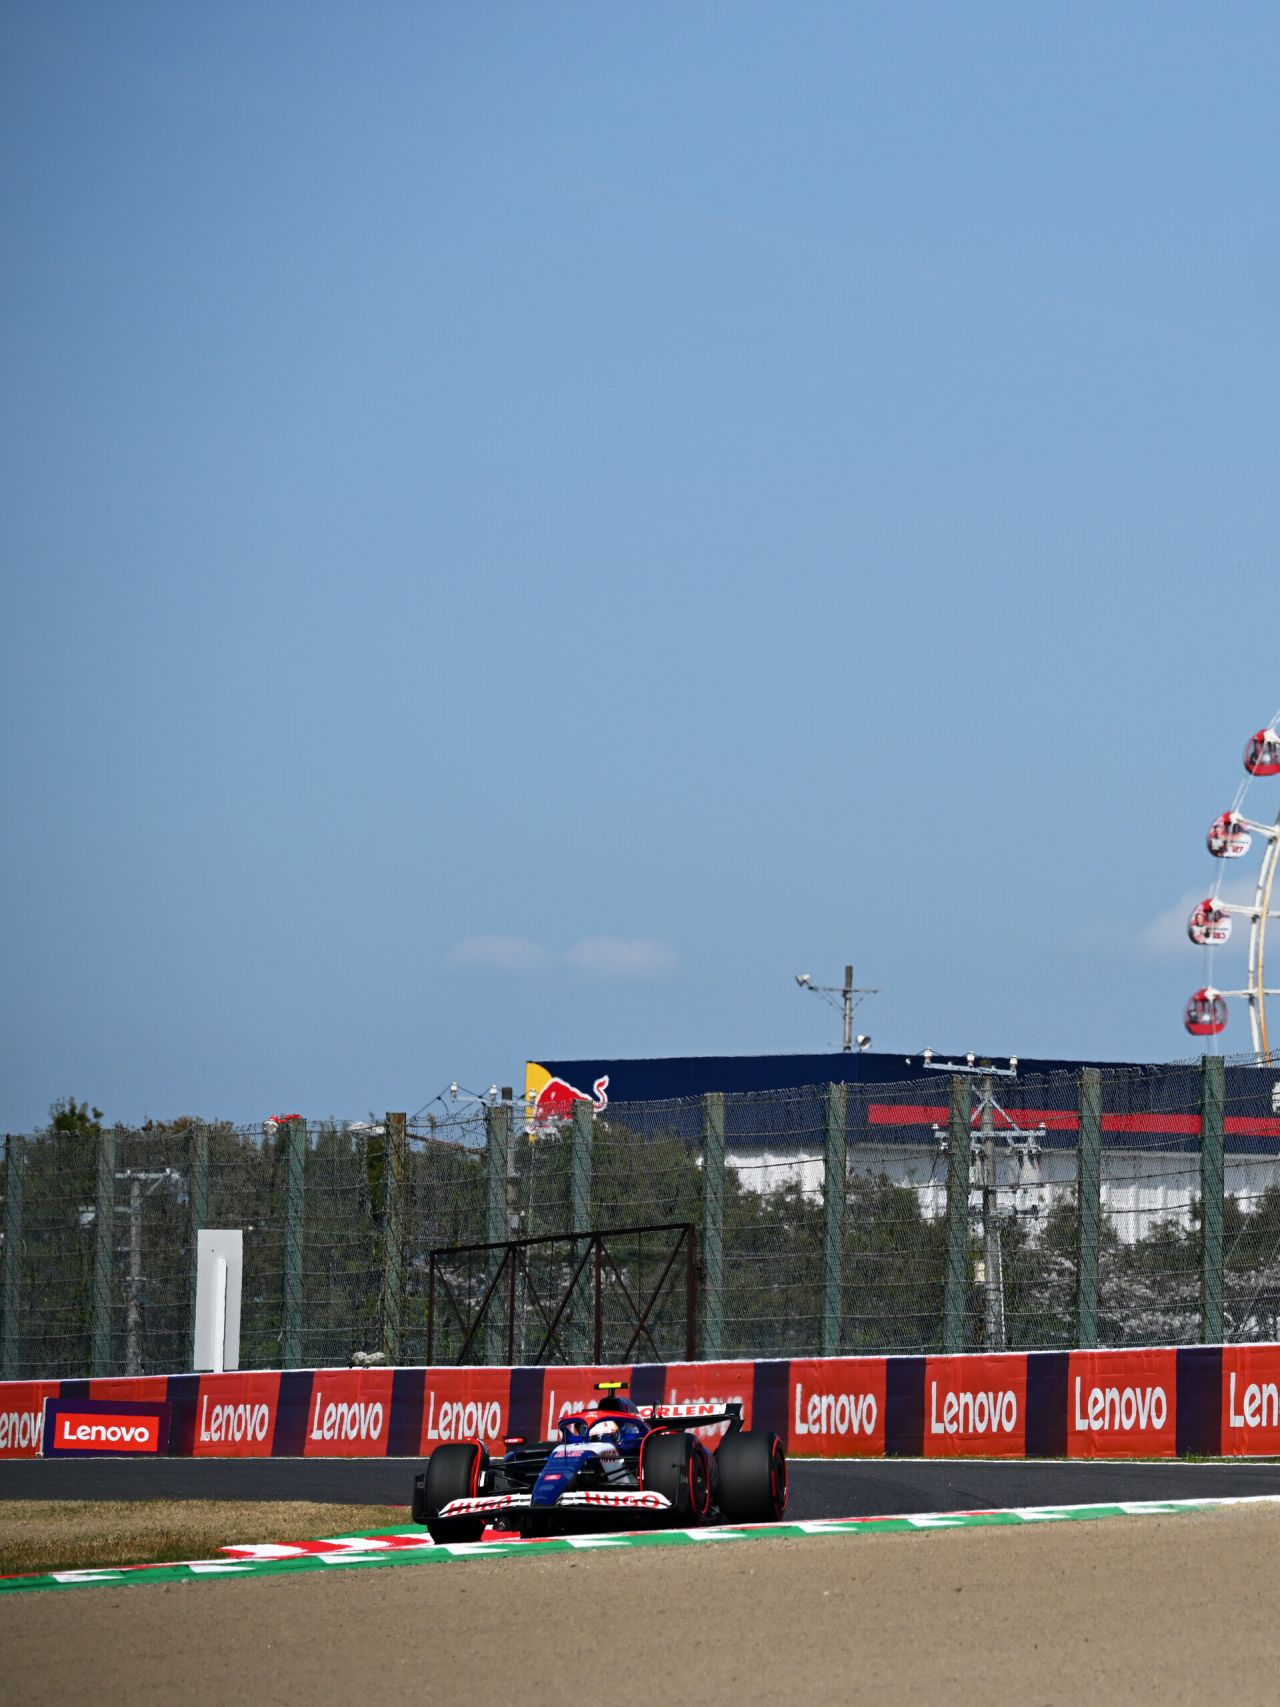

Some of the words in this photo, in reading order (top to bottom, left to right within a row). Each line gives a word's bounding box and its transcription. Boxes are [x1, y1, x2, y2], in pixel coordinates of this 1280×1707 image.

[201, 1395, 269, 1441] Lenovo
[311, 1392, 383, 1440] Lenovo
[428, 1392, 501, 1440] Lenovo
[640, 1405, 714, 1418] ORLEN
[795, 1383, 877, 1435] Lenovo
[931, 1381, 1017, 1434] Lenovo
[1076, 1376, 1167, 1430] Lenovo
[64, 1421, 149, 1442] Lenovo
[584, 1491, 661, 1509] HUGO
